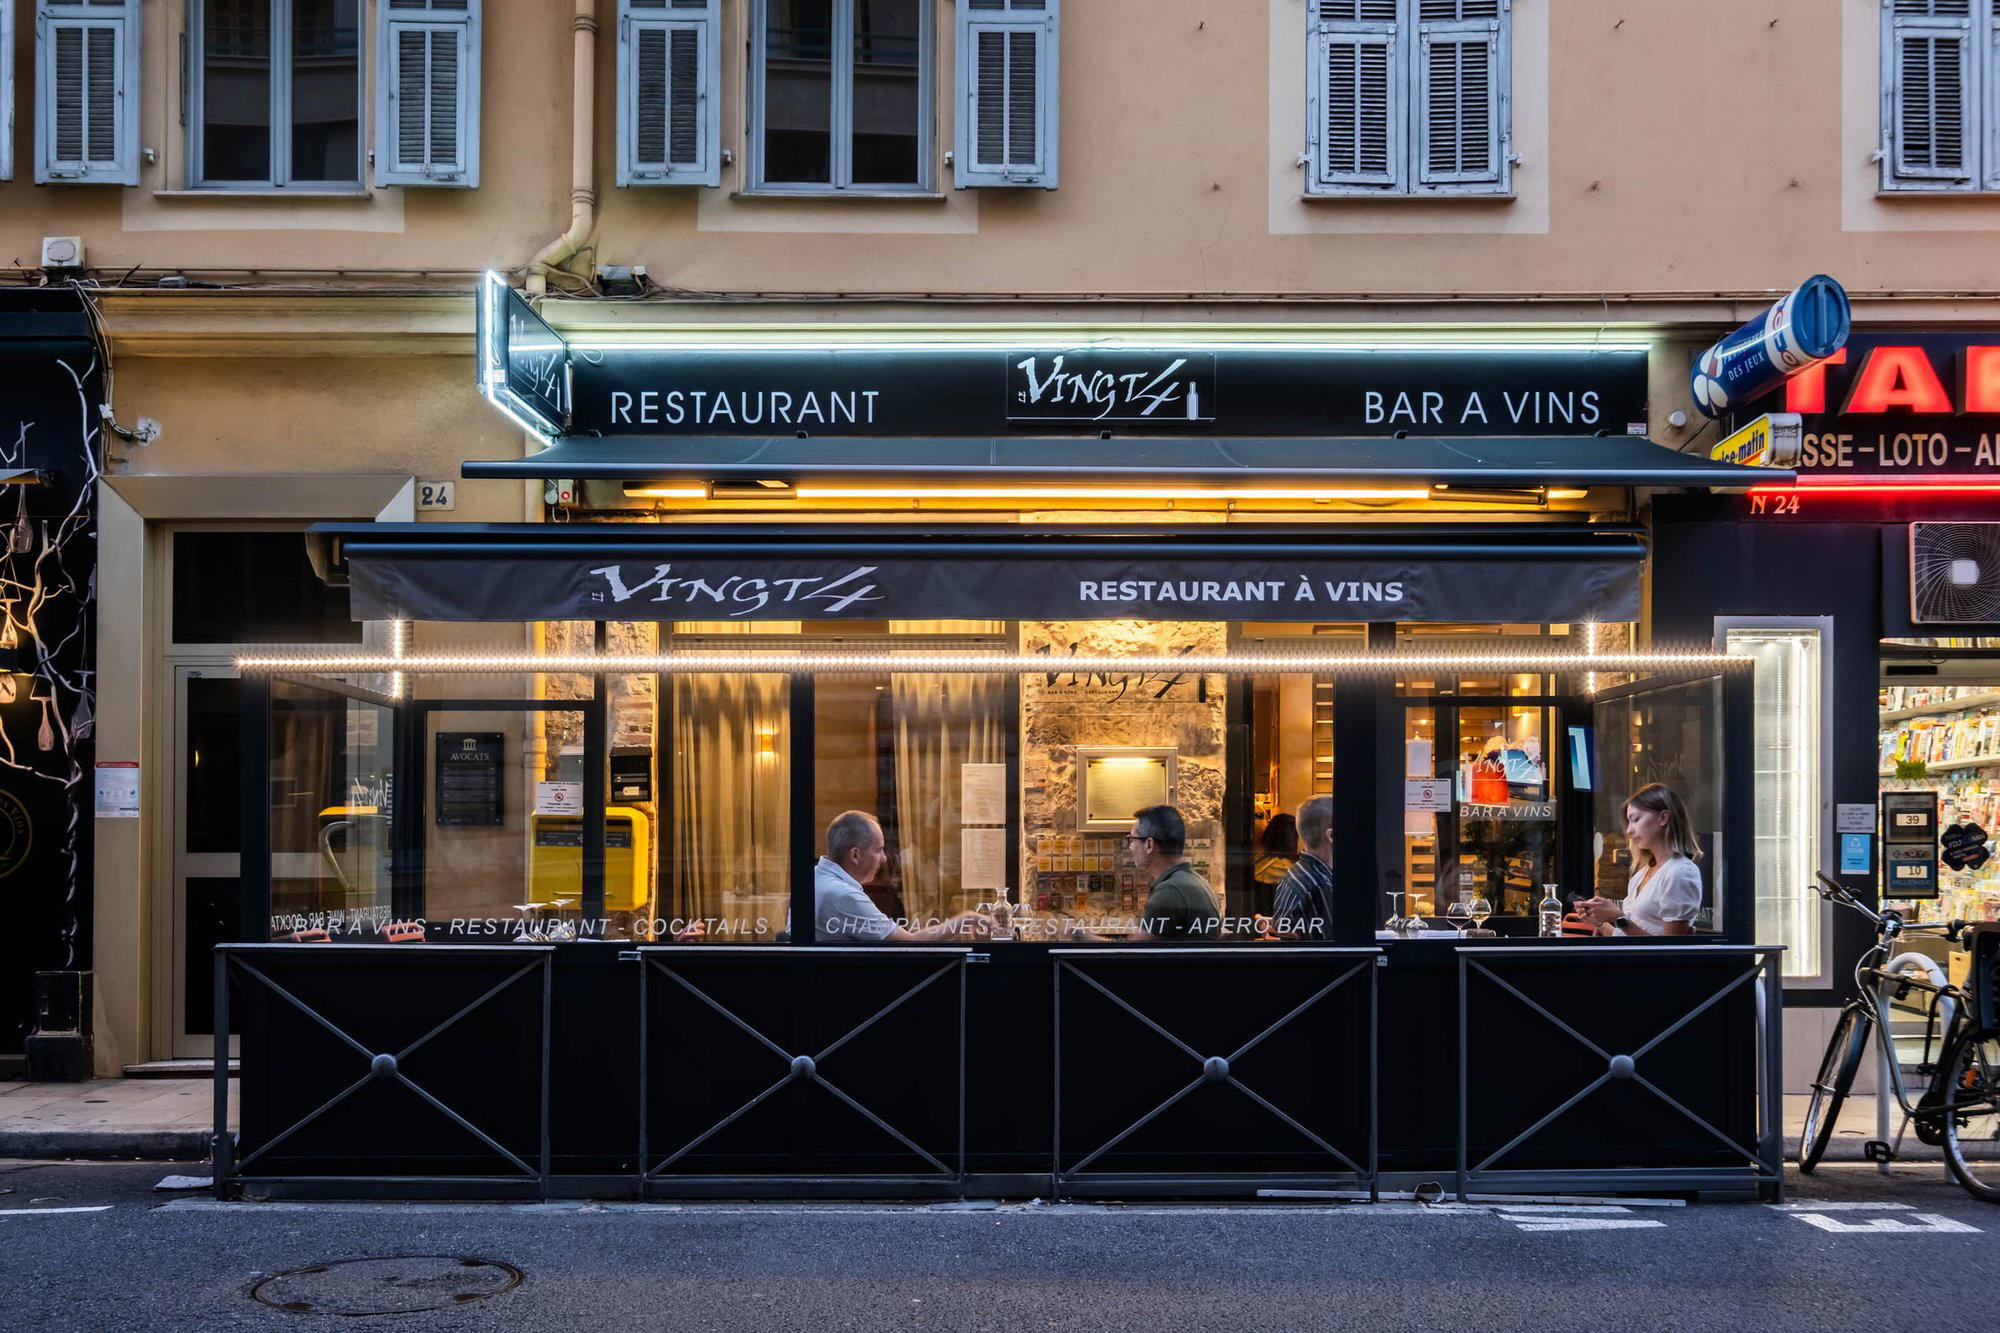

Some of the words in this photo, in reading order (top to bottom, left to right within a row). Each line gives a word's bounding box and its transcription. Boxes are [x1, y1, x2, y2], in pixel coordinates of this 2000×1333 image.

[1728, 364, 1743, 381] DES
[1744, 352, 1765, 373] JEUX
[611, 390, 880, 425] RESTAURANT
[1365, 391, 1445, 424] BAR
[1460, 391, 1489, 424] A
[1503, 390, 1601, 425] VINS
[1718, 429, 1765, 465] ice-matin
[1798, 432, 1854, 467] SSE
[1879, 432, 1949, 467] LOTO
[1974, 433, 2000, 466] A
[422, 486, 448, 506] 24
[1750, 495, 1767, 515] N
[1773, 495, 1800, 514] 24
[1079, 580, 1286, 602] RESTAURANT
[1294, 574, 1316, 602] À
[1325, 580, 1404, 602] VINS
[450, 752, 490, 761] AVOCATS
[1459, 805, 1493, 818] BAR
[1495, 805, 1507, 818] A
[1513, 805, 1552, 818] VINS
[1905, 815, 1920, 825] 39
[1908, 866, 1922, 876] 10
[293, 918, 342, 935] BAR
[347, 918, 363, 935] A
[372, 917, 427, 935] VINS
[449, 917, 612, 936] RESTAURANT
[634, 917, 769, 936] COCKTAILS
[825, 916, 994, 935] CHAMPAGNES
[1011, 916, 1170, 935] RESTAURANT
[1188, 916, 1270, 935] APERO
[1277, 916, 1325, 935] BAR
